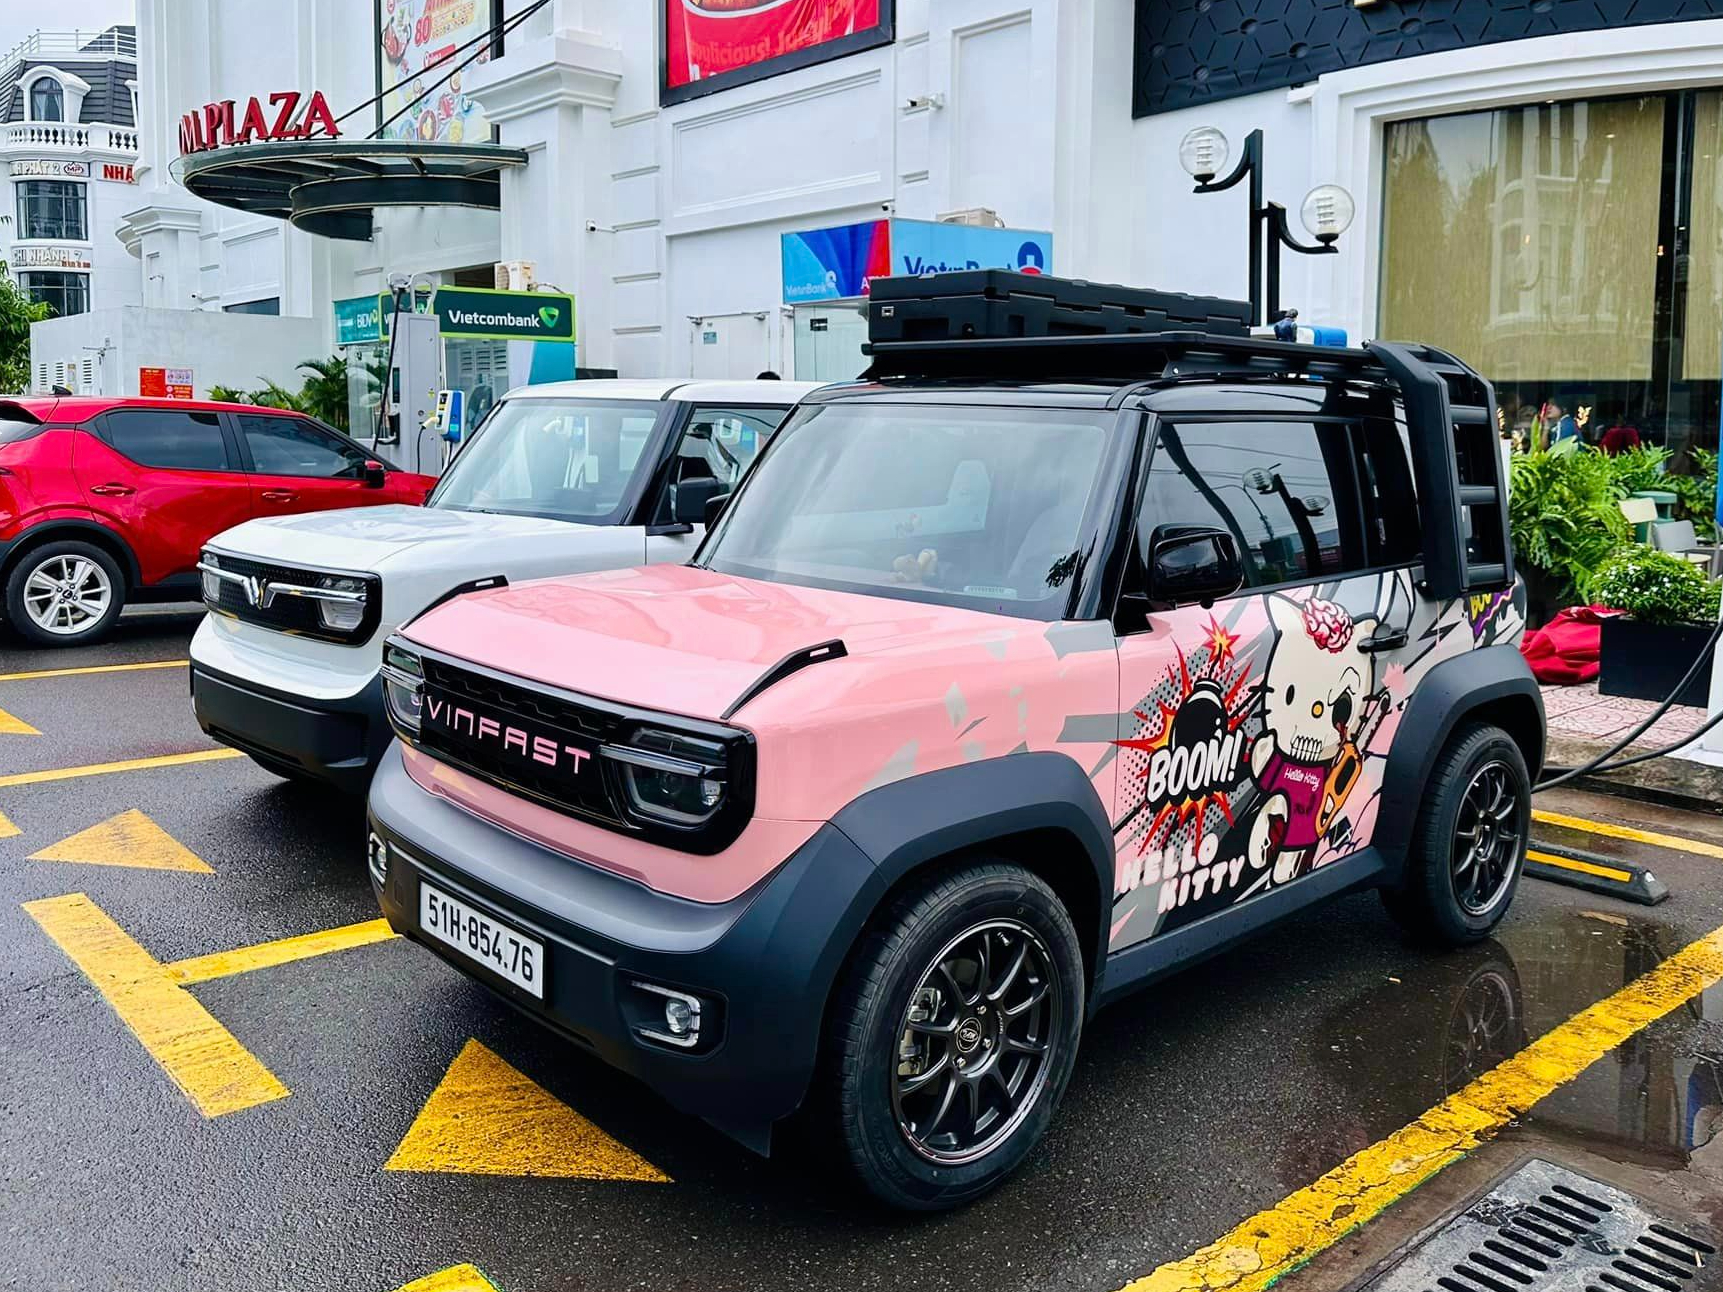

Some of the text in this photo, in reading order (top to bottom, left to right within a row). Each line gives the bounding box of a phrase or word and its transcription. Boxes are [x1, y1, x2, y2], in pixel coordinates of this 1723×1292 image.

[448, 309, 540, 328] Vietcombank
[427, 695, 591, 774] VINFAST
[1147, 729, 1243, 802] BOOM!
[1284, 767, 1320, 792] Hello Kitty
[1116, 833, 1219, 893] HELLO
[1157, 855, 1245, 914] KITTY
